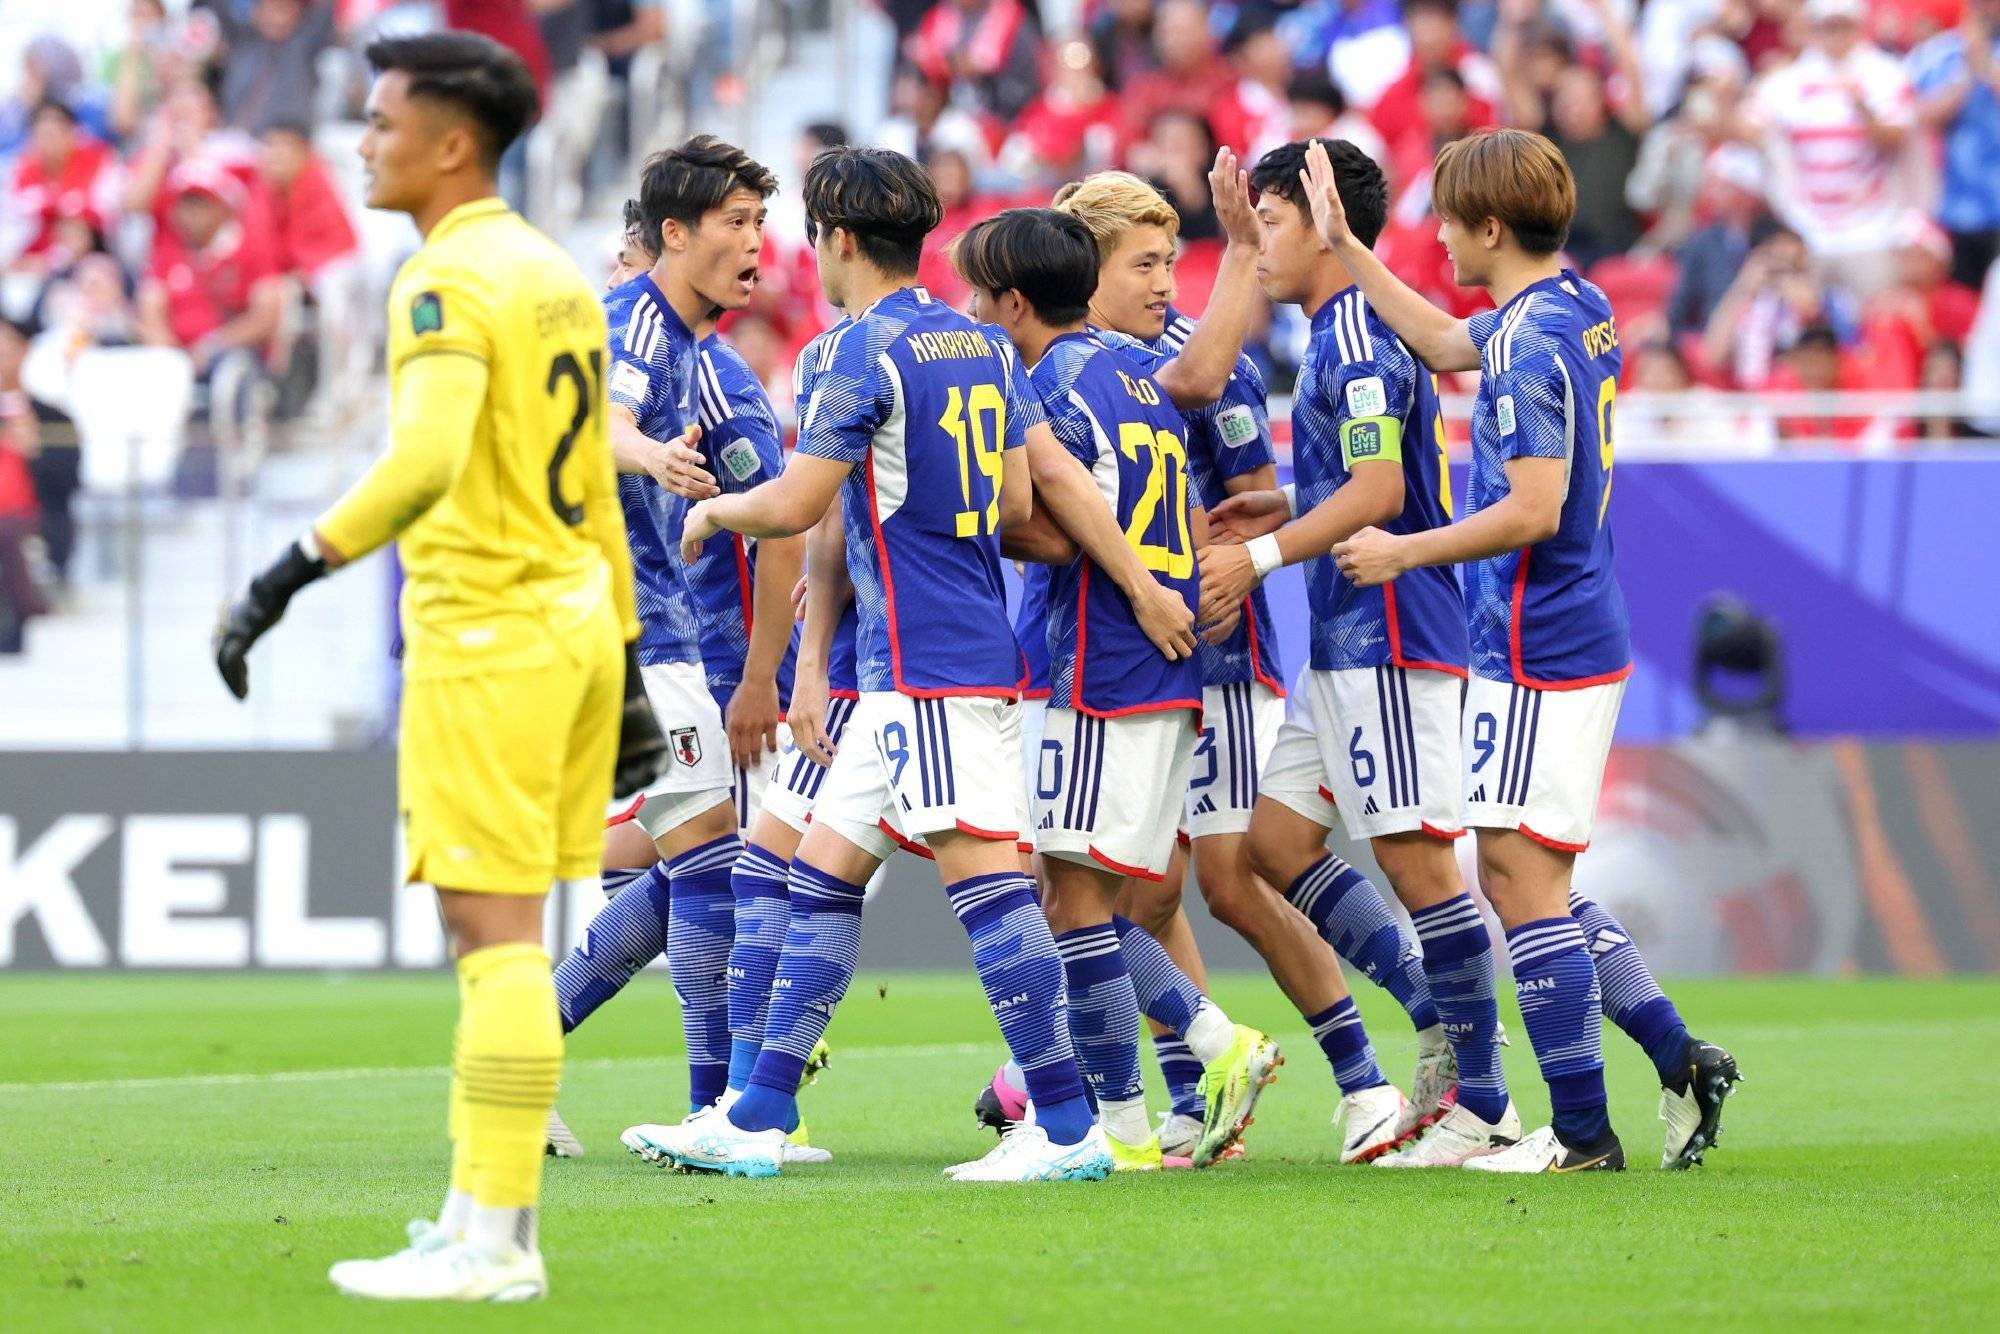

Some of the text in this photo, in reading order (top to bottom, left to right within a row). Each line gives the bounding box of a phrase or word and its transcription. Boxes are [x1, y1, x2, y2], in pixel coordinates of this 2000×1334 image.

[906, 330, 993, 363] NAKAYAMA
[1353, 391, 1378, 402] LIVE
[1224, 416, 1250, 431] LIVE
[1351, 432, 1377, 444] LIVE
[1352, 426, 1367, 434] AFC
[938, 383, 1005, 538] 19
[1597, 375, 1617, 529] 9
[1118, 422, 1194, 579] 20
[874, 720, 910, 790] 9
[1188, 727, 1218, 791] 3
[1350, 726, 1376, 787] 6
[1471, 712, 1497, 773] 9
[1036, 739, 1063, 800] 0
[991, 992, 1029, 1013] PAN
[1516, 977, 1556, 996] PAN
[1440, 1022, 1474, 1033] PAN
